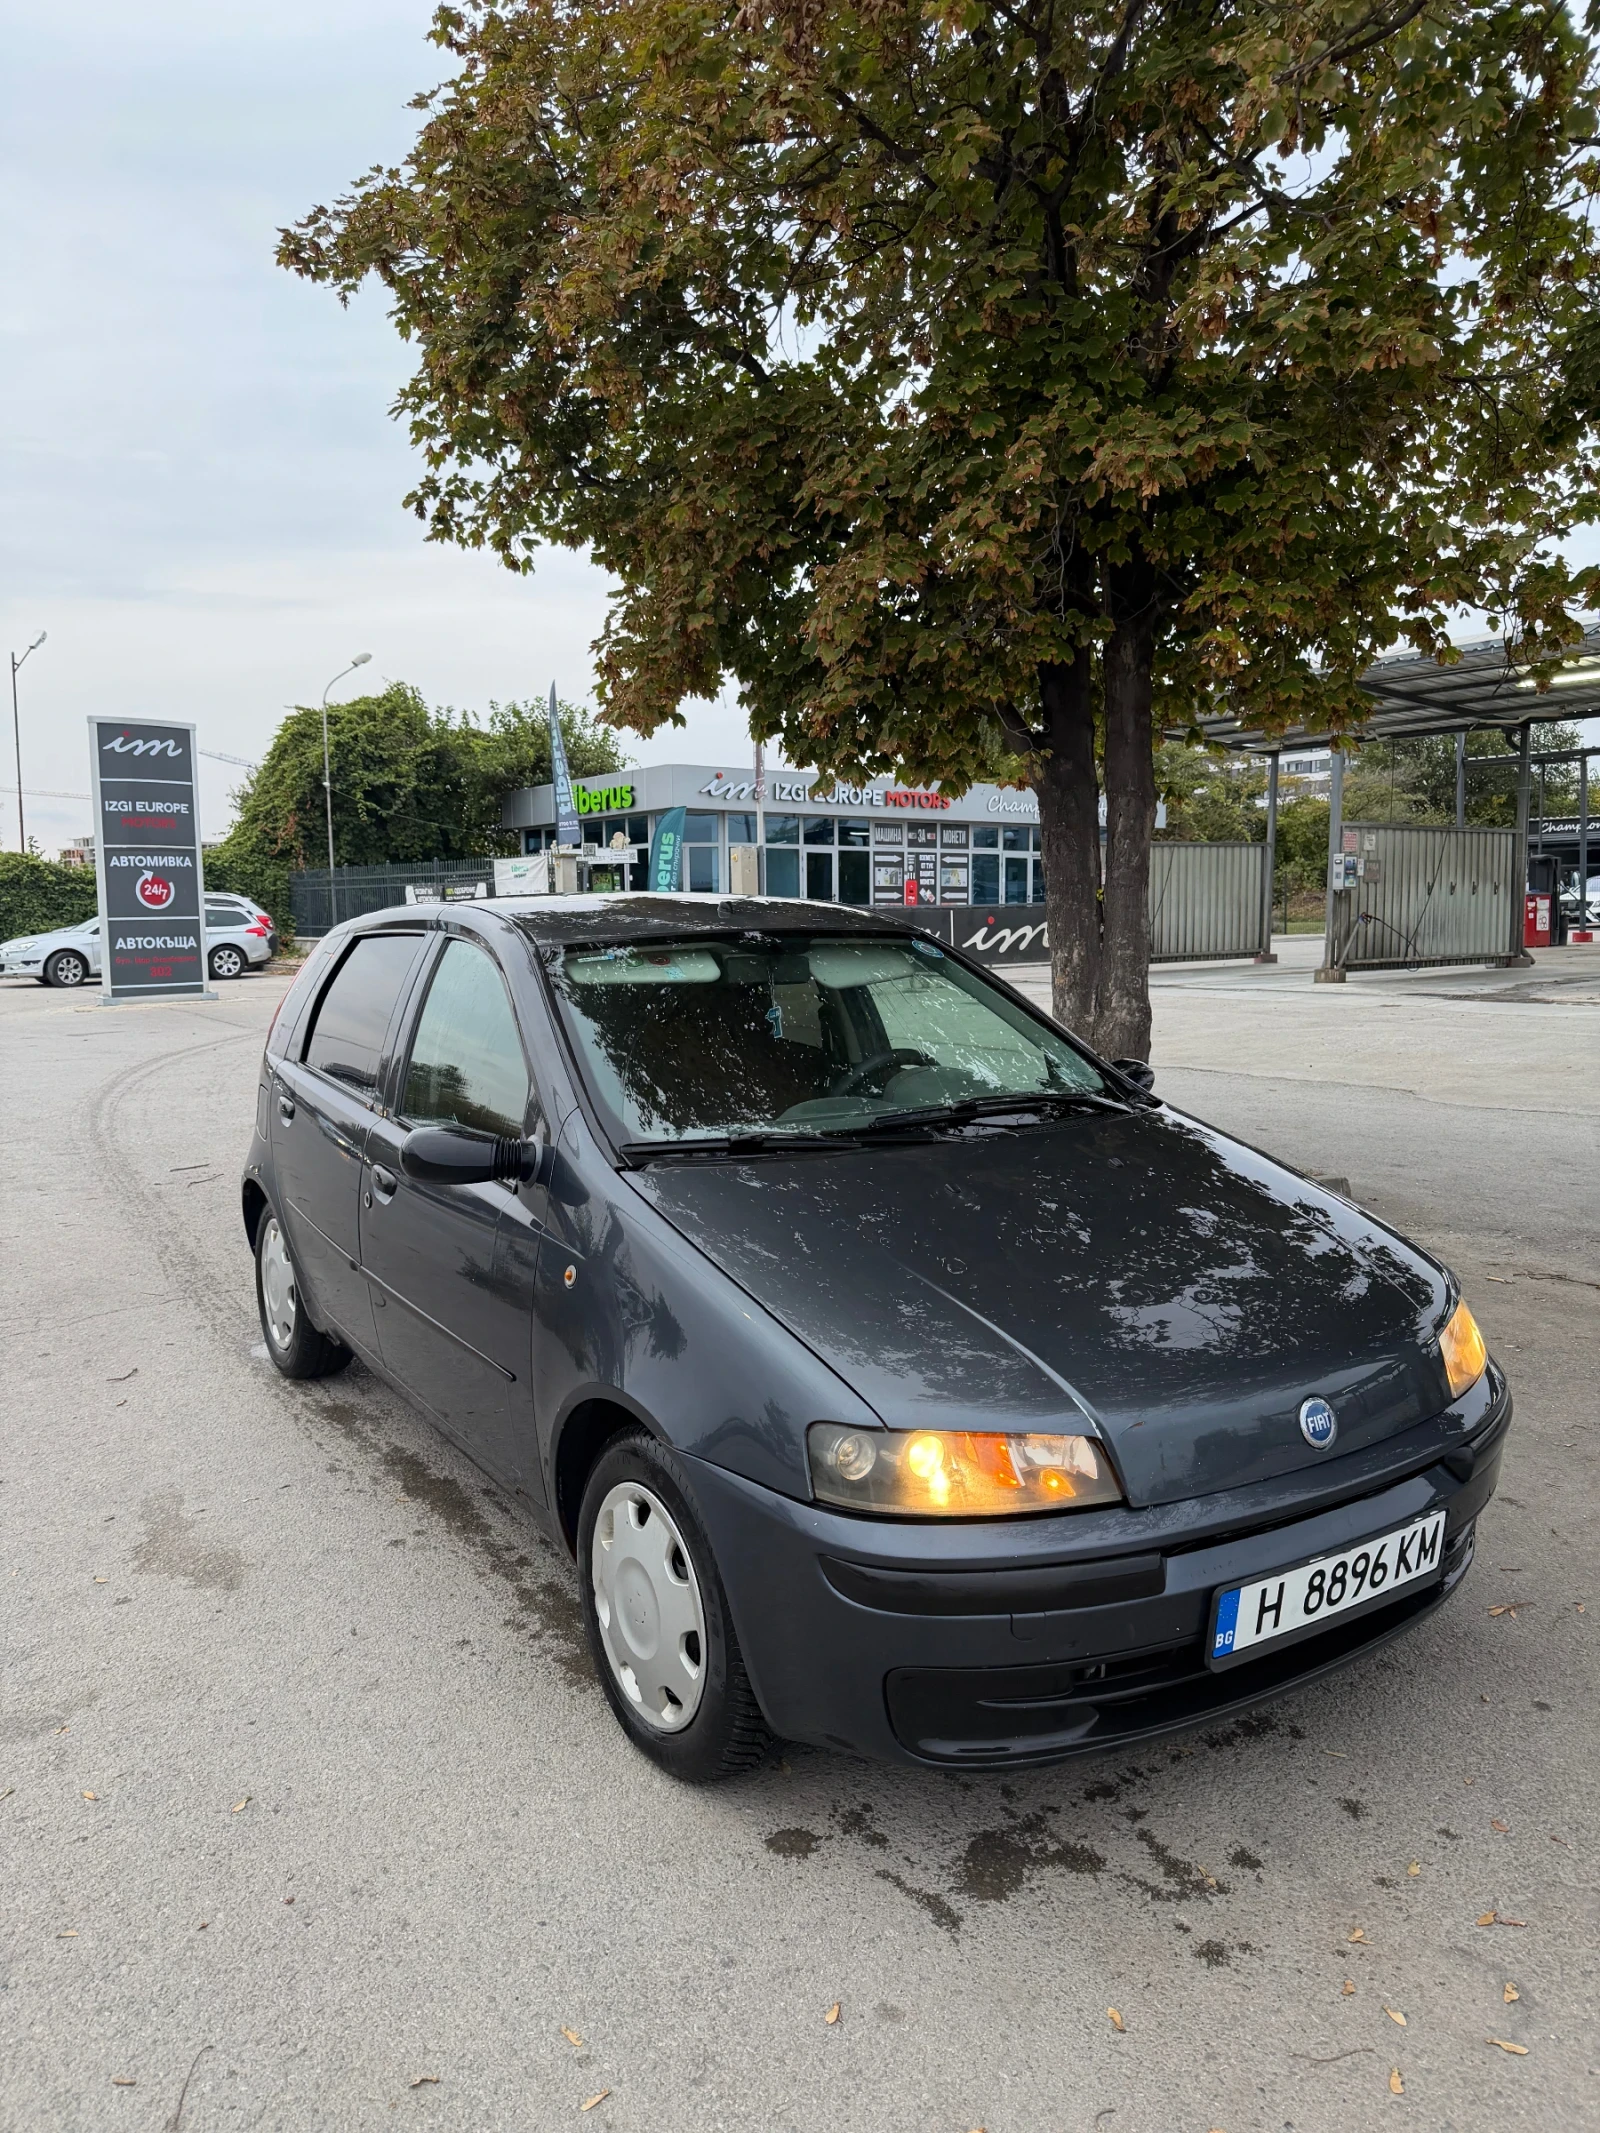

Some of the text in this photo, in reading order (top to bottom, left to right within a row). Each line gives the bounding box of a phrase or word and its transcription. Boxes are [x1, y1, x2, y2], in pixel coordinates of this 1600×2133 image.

[104, 800, 189, 814] IZGI EUROPE
[572, 785, 634, 814] iberus
[886, 791, 951, 809] MOTORS
[121, 816, 177, 829] MOTORS
[1541, 822, 1600, 833] Champon
[875, 828, 966, 844] МАШИНА ЗА МОНЕТИ
[109, 855, 193, 868] АВТОМИВКА
[144, 884, 168, 900] 24/7
[115, 936, 197, 950] АВТОКЪЩА
[149, 966, 172, 977] 302
[1306, 1411, 1331, 1434] FIAT
[1255, 1520, 1440, 1635] H 8896 KM
[1215, 1629, 1234, 1649] BG
